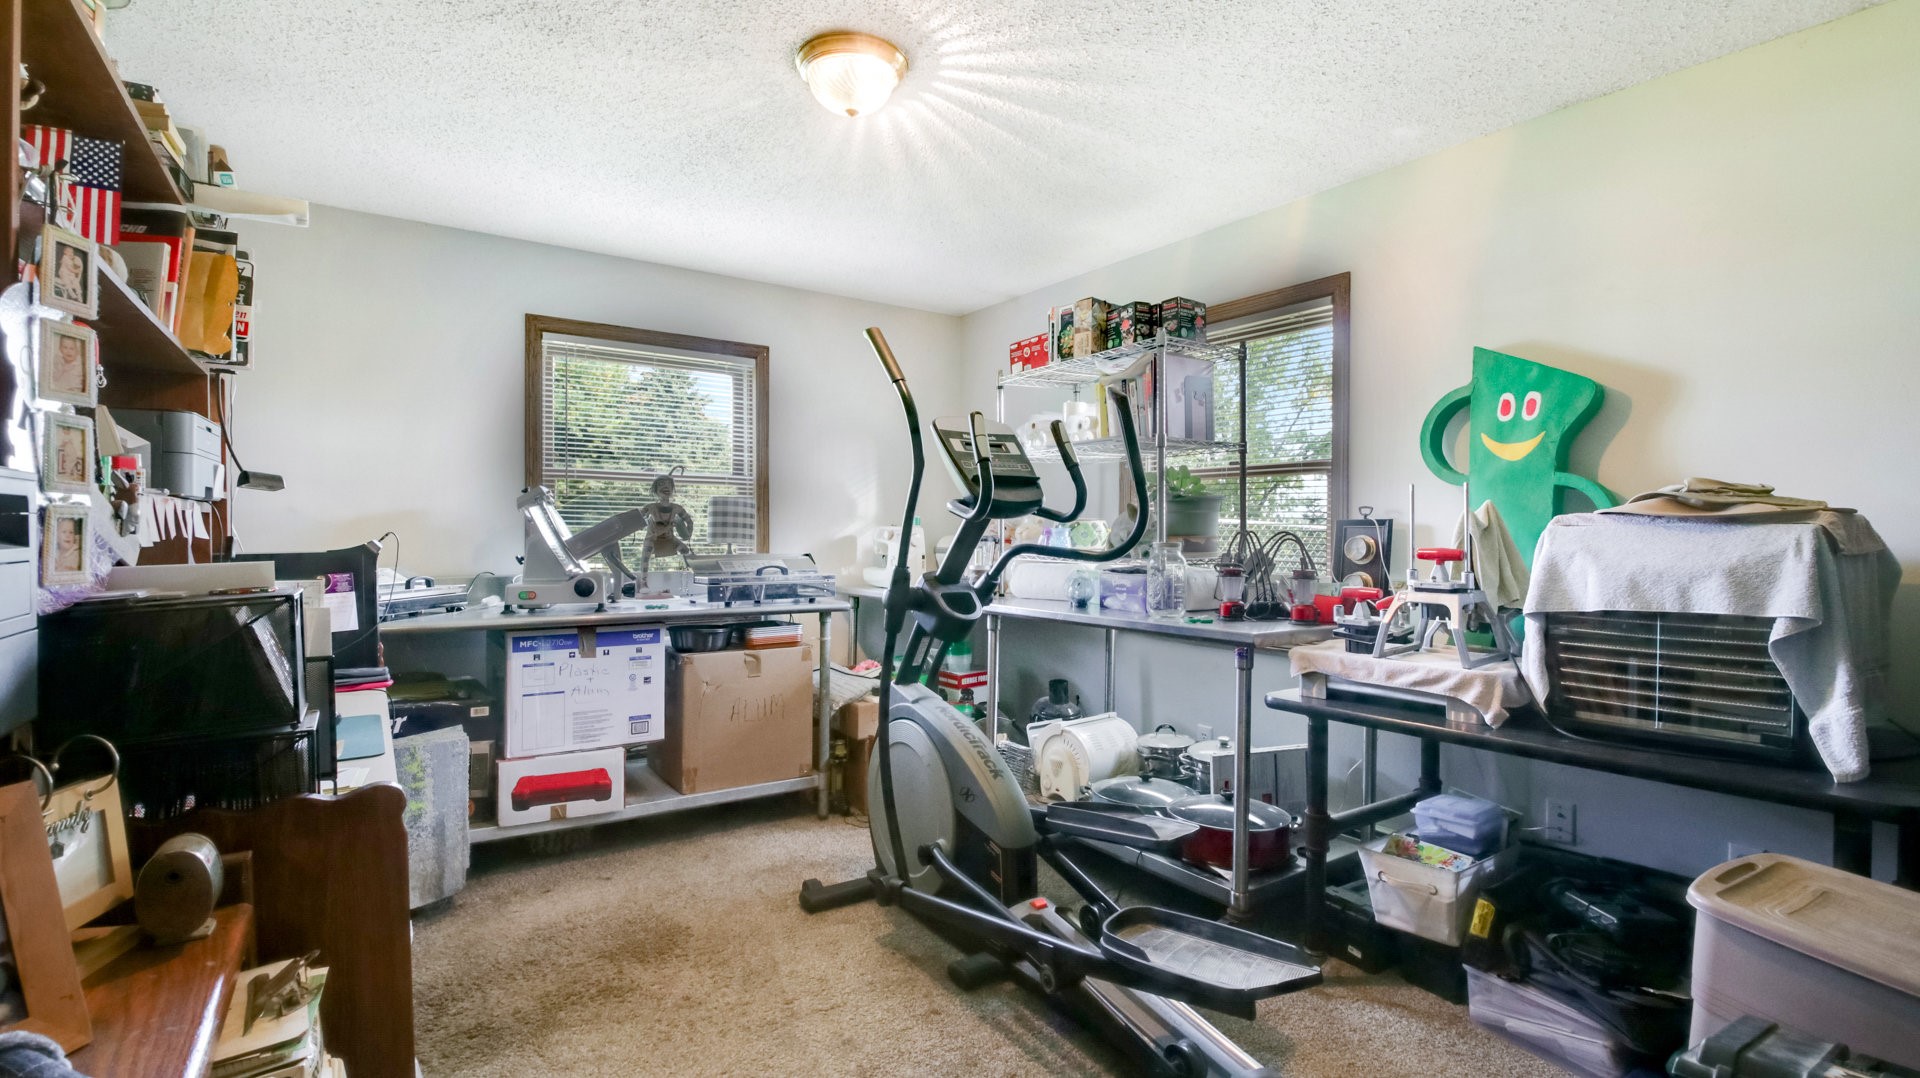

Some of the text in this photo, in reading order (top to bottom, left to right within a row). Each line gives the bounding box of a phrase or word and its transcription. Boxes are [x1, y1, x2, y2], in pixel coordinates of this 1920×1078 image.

[119, 224, 148, 234] CHO
[632, 632, 655, 640] brother
[558, 662, 610, 677] Plastic
[730, 694, 785, 722] ALUM
[935, 705, 1005, 781] NordicTrack
